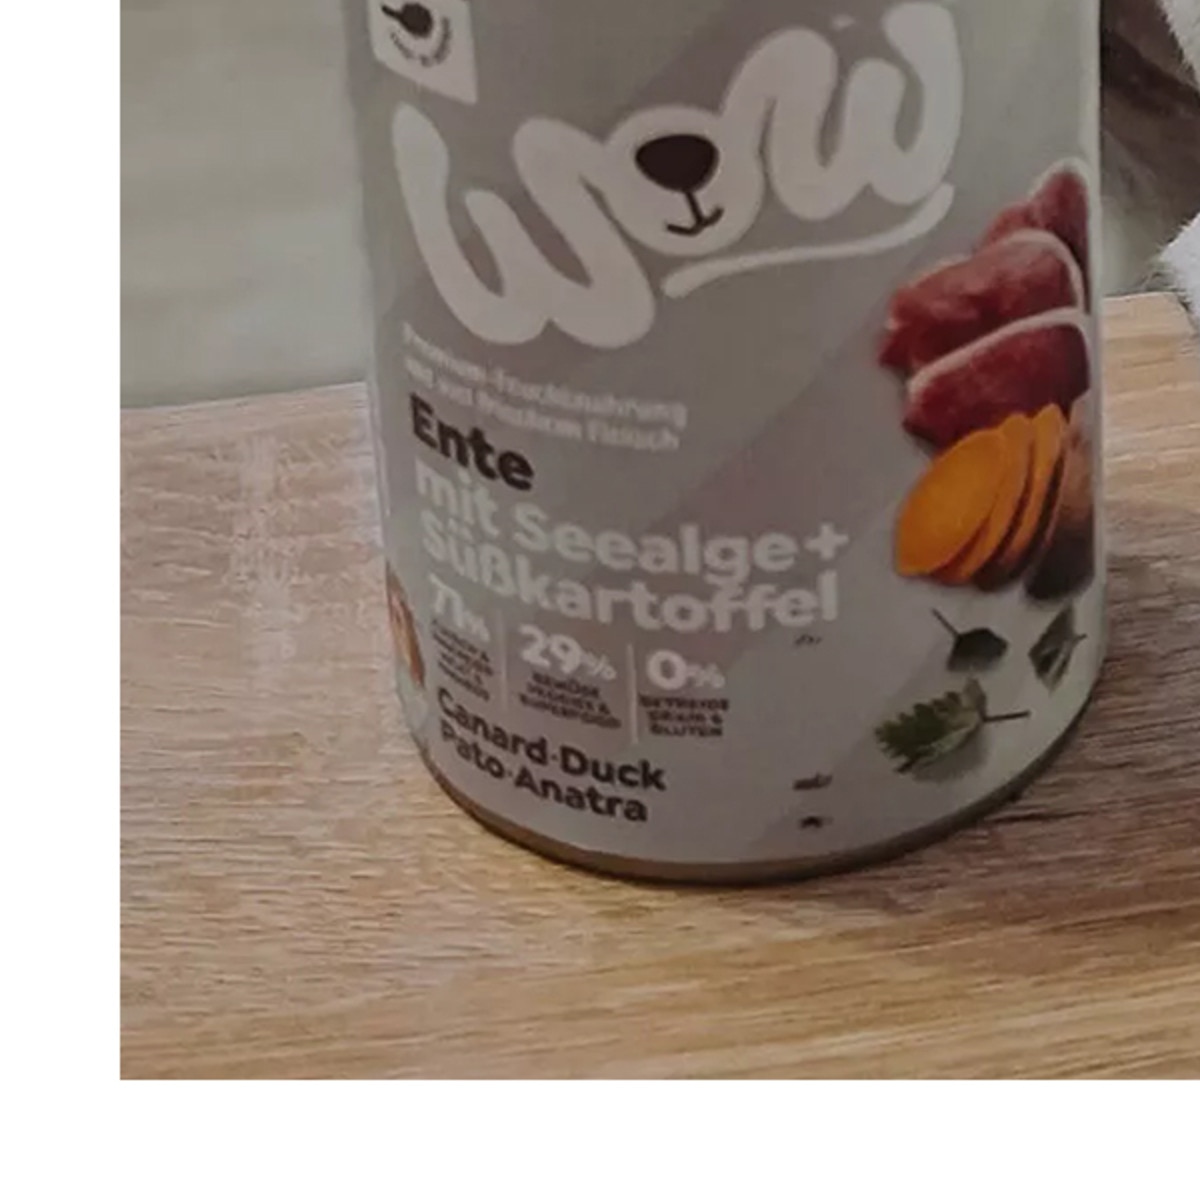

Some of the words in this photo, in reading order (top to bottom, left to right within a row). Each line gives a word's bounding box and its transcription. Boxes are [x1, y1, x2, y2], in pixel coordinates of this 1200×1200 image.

[409, 392, 534, 491] Ente
[414, 458, 500, 539] mit
[420, 509, 838, 632] Süßkartoffel
[518, 625, 617, 681] 29%
[646, 649, 726, 691] 0%
